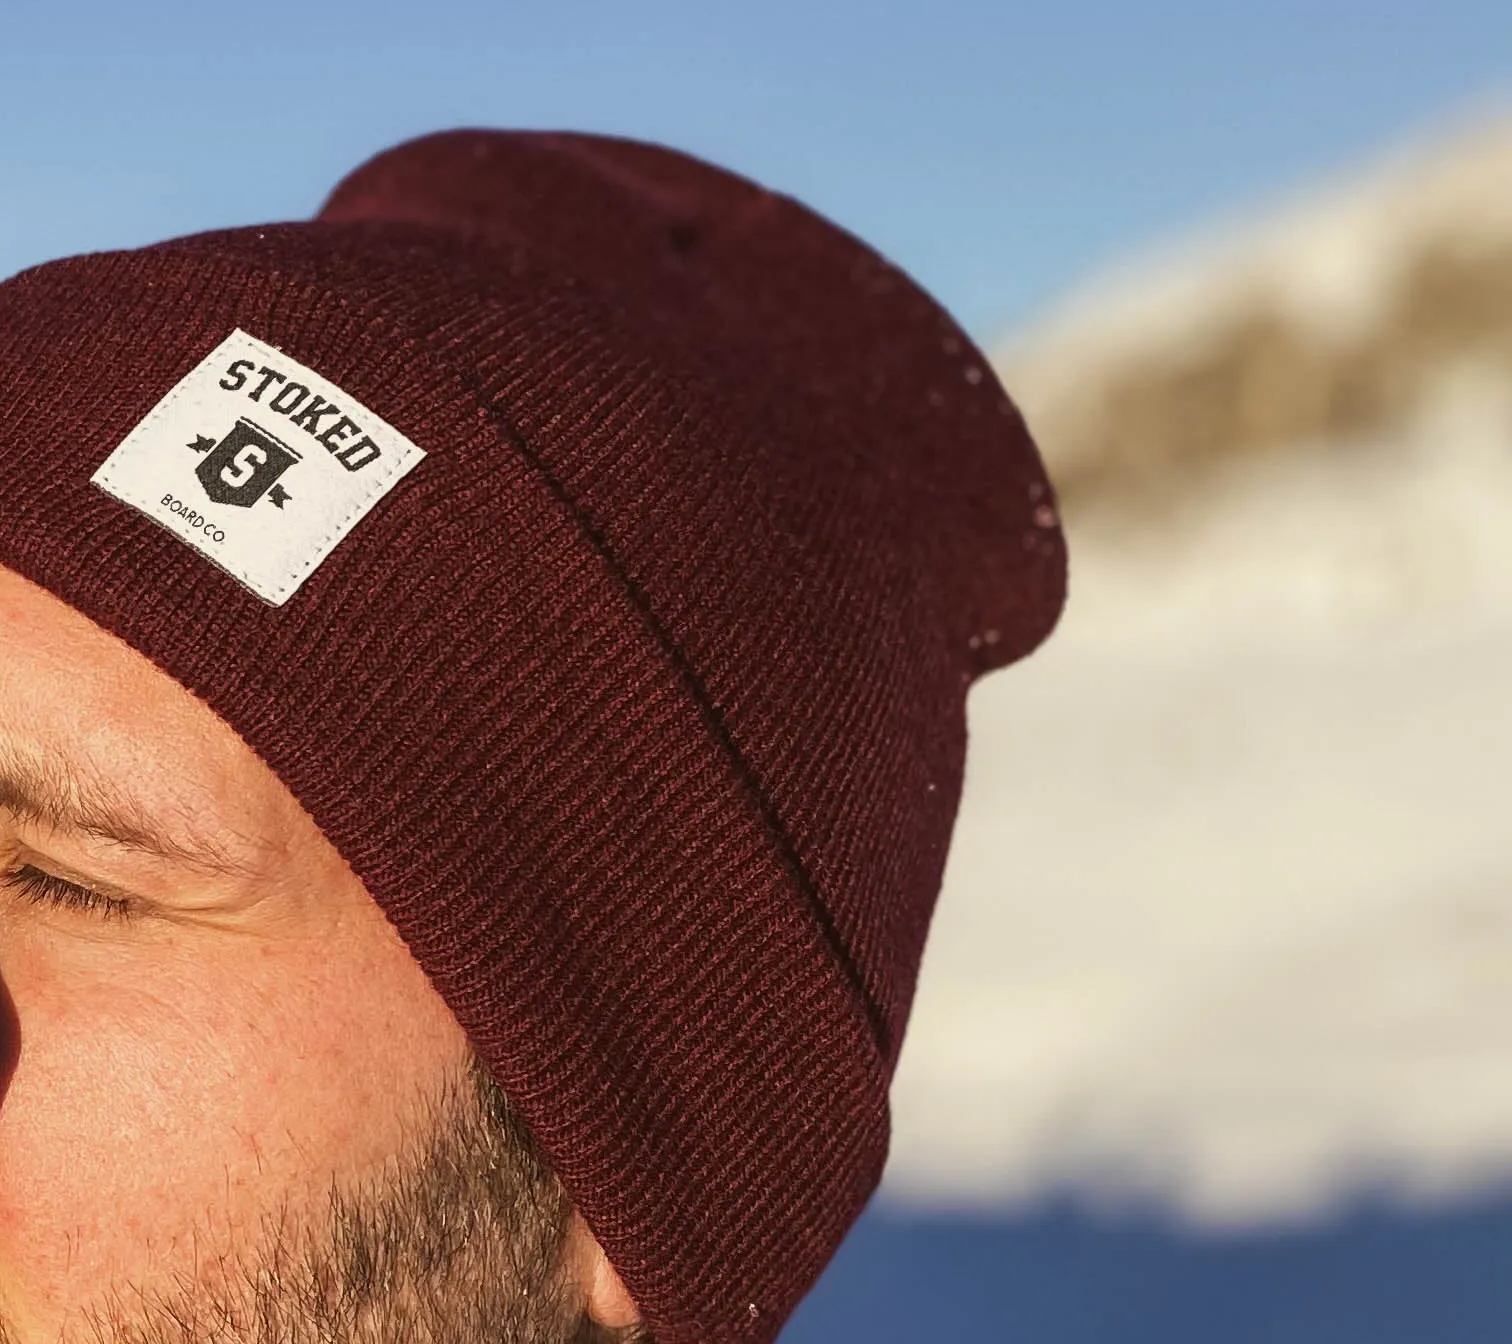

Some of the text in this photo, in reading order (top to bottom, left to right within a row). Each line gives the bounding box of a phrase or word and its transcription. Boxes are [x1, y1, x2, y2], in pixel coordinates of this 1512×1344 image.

[219, 359, 381, 472] STOKED
[220, 444, 267, 488] S
[160, 493, 205, 528] BOARD
